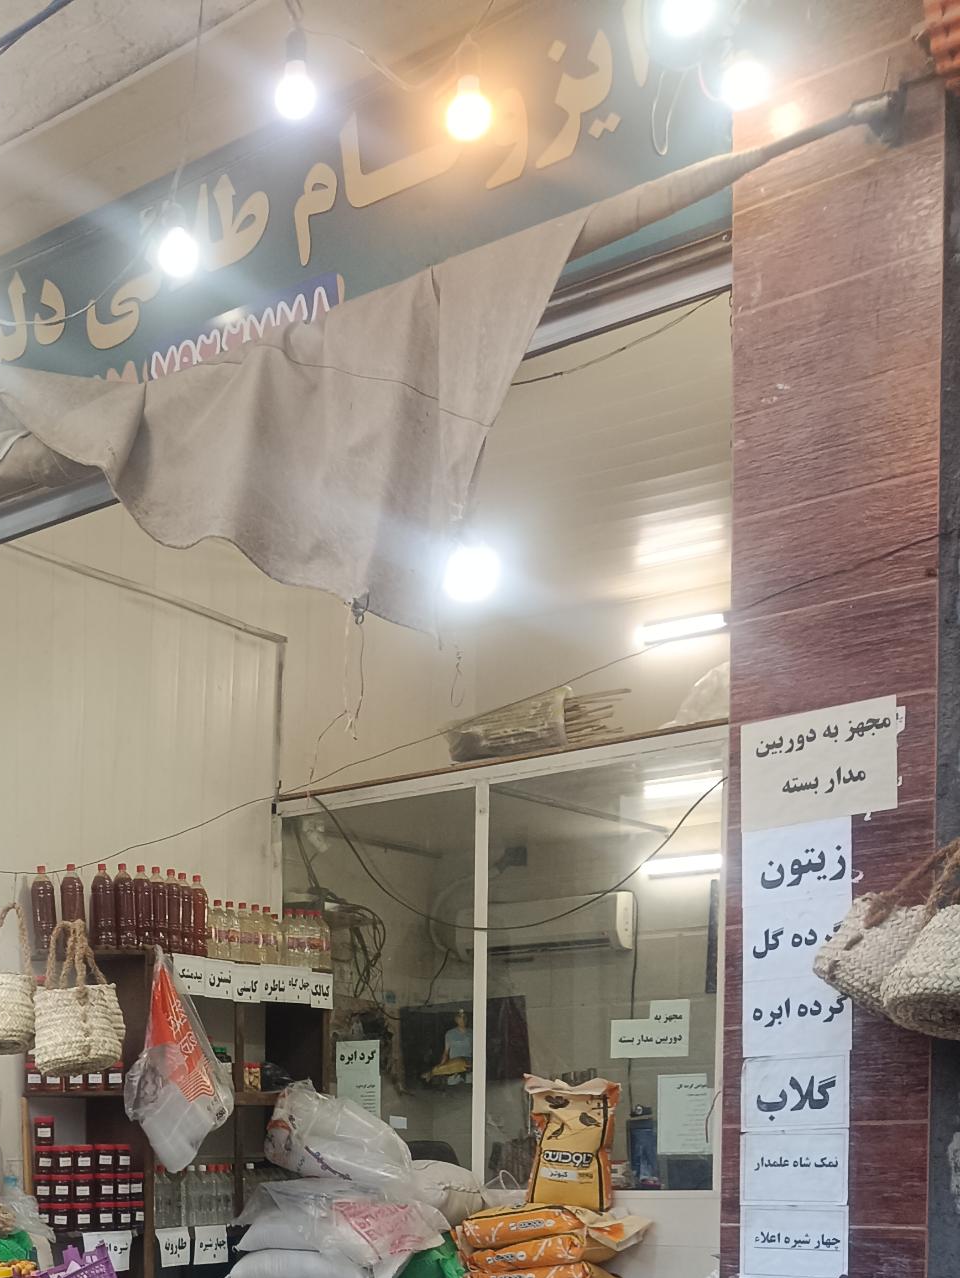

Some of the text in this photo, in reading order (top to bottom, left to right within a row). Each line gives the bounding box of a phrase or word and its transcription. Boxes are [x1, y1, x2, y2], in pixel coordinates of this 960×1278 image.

[755, 714, 891, 757] مجهز به دوربین
[782, 766, 866, 794] مدار بسته
[760, 845, 846, 889] زیتون
[753, 927, 785, 959] گل
[179, 968, 203, 983] بیدمشک
[208, 970, 232, 987] نسترن
[236, 979, 259, 996] کاسنی
[654, 1013, 683, 1024] مجهز به
[753, 994, 848, 1028] گرده ابره
[618, 1033, 683, 1046] دوربین مدار بسته
[756, 1074, 837, 1122] گلاب
[754, 1156, 839, 1171] نمک شاه علمدار
[200, 1238, 226, 1254] چهار شیره
[784, 1233, 811, 1248] شیره
[814, 1233, 840, 1250] چهار
